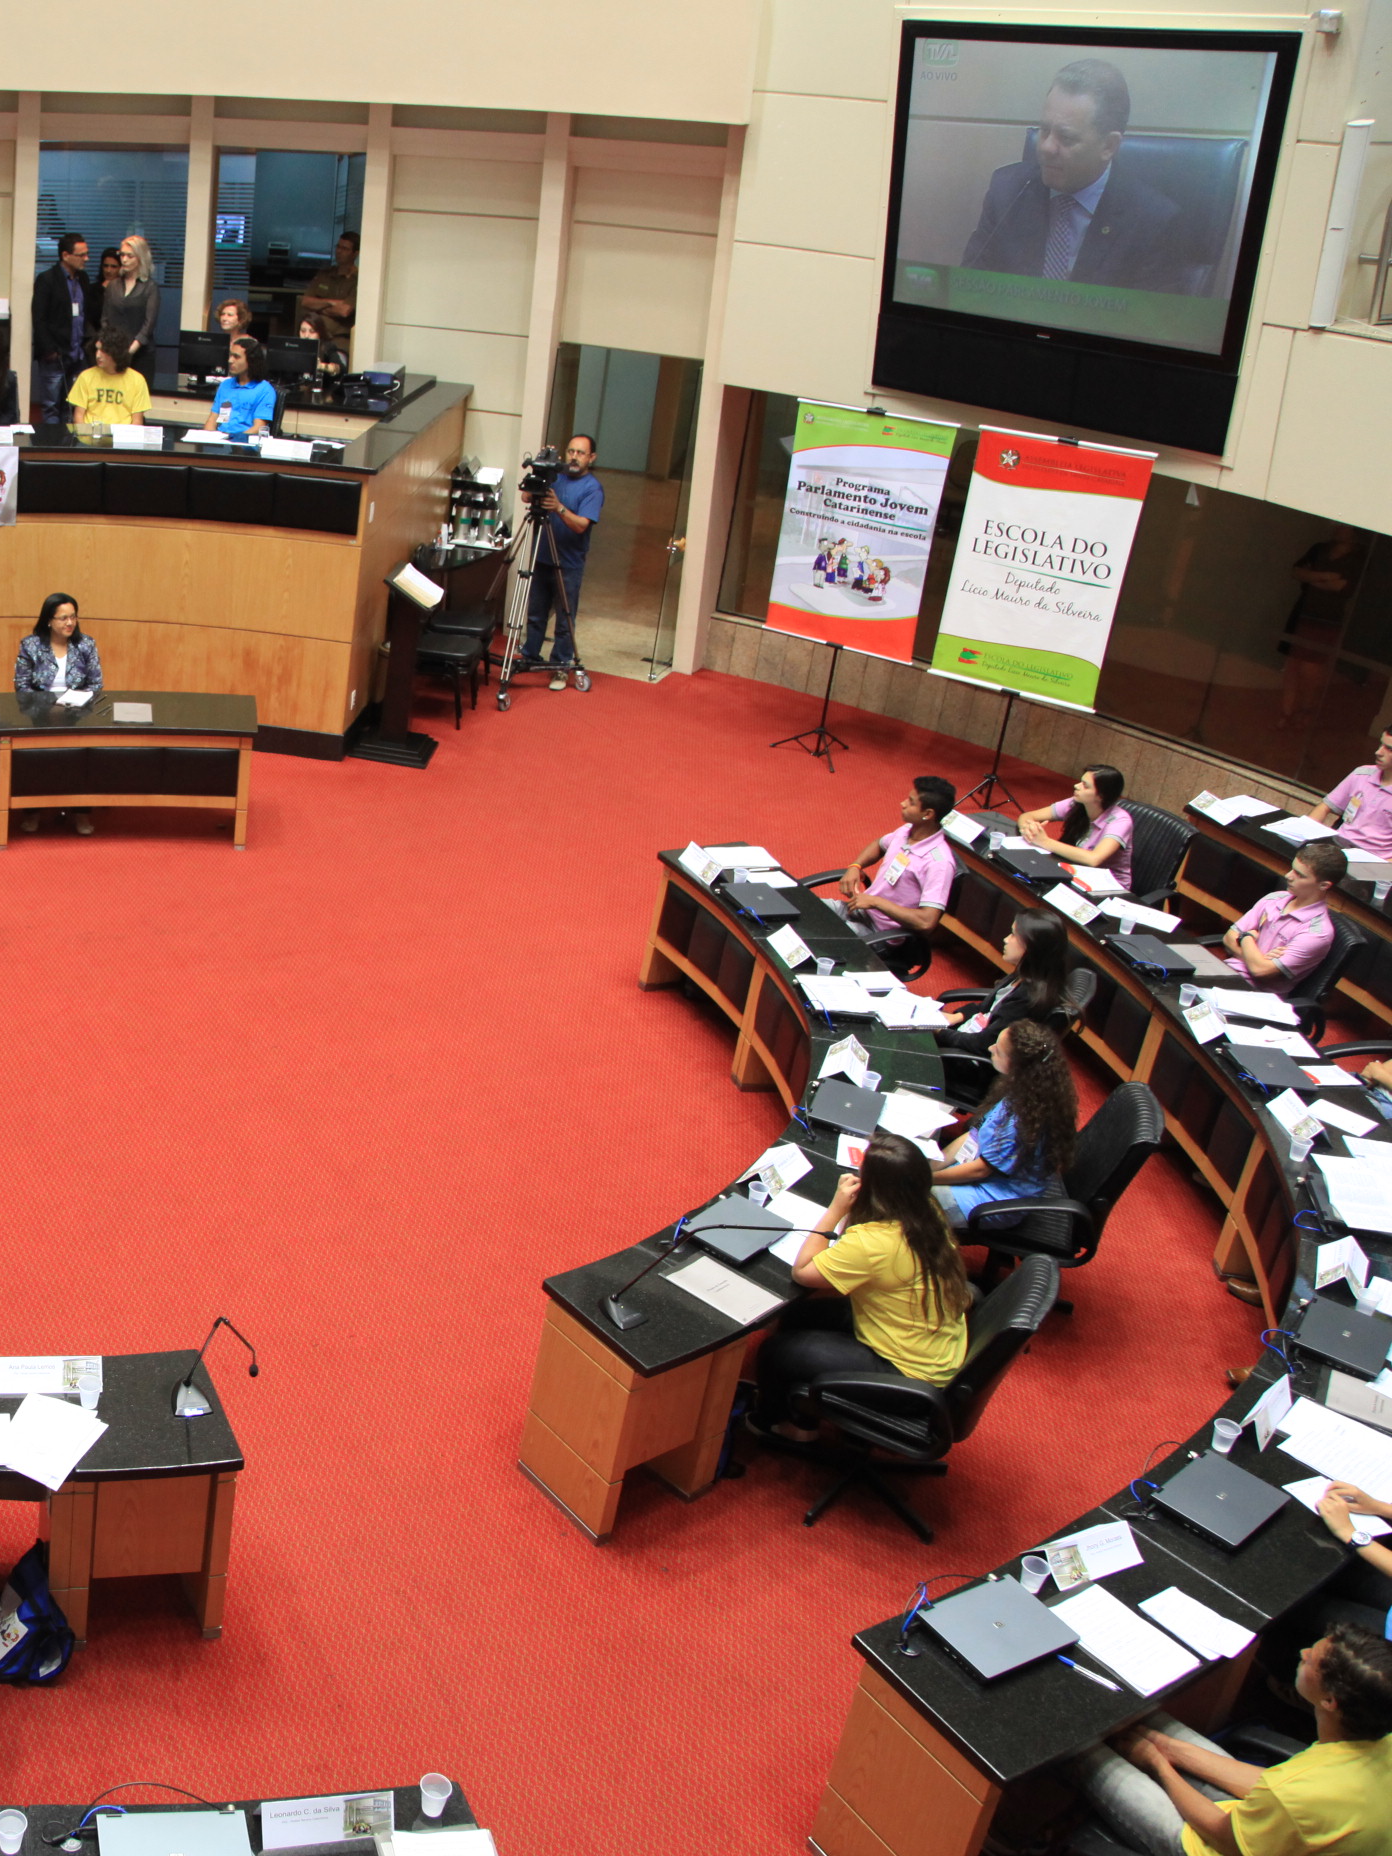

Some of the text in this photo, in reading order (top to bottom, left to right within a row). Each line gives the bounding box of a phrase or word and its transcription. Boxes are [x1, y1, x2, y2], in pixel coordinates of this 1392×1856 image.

[934, 72, 958, 82] VIVO
[1081, 295, 1128, 313] JOVEM
[796, 480, 929, 517] Parlamento Jovem
[835, 476, 891, 496] Programa
[823, 498, 896, 521] Catarinense
[789, 507, 839, 523] Construindo
[847, 518, 886, 532] cidadania
[887, 527, 898, 535] na
[899, 528, 927, 542] escola
[983, 519, 1109, 559] ESCOLA DO
[972, 537, 1112, 580] LEGISLATIVO
[1004, 570, 1061, 596] Deputado
[990, 587, 1032, 609] Mauro
[1033, 596, 1050, 611] da
[1055, 600, 1103, 623] Silveira
[269, 1809, 302, 1819] Leonardo
[323, 1805, 340, 1813] Silva
